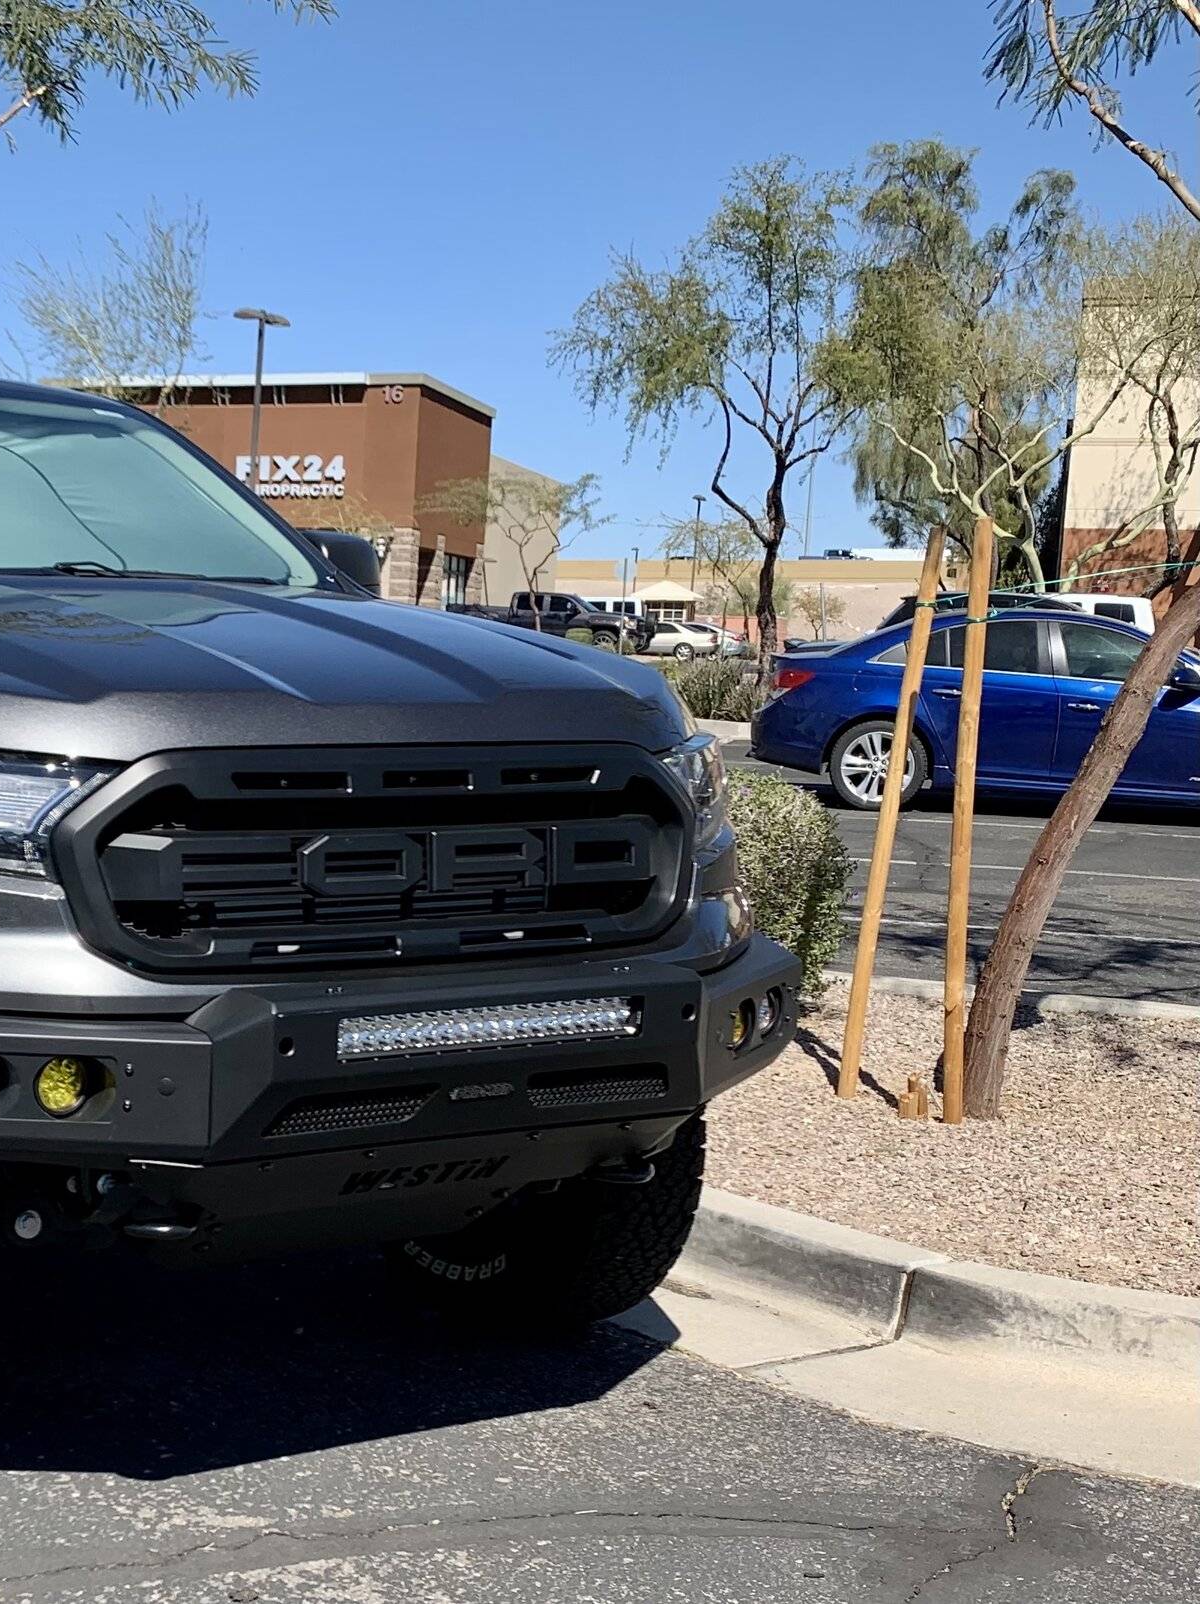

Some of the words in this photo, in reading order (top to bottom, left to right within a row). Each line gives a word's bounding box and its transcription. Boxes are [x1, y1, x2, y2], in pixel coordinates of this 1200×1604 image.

[382, 385, 404, 404] 16
[235, 455, 346, 482] FIX24
[248, 483, 345, 497] IROPRACTIC
[106, 823, 653, 905] FORD
[404, 1241, 506, 1281] GRABBER
